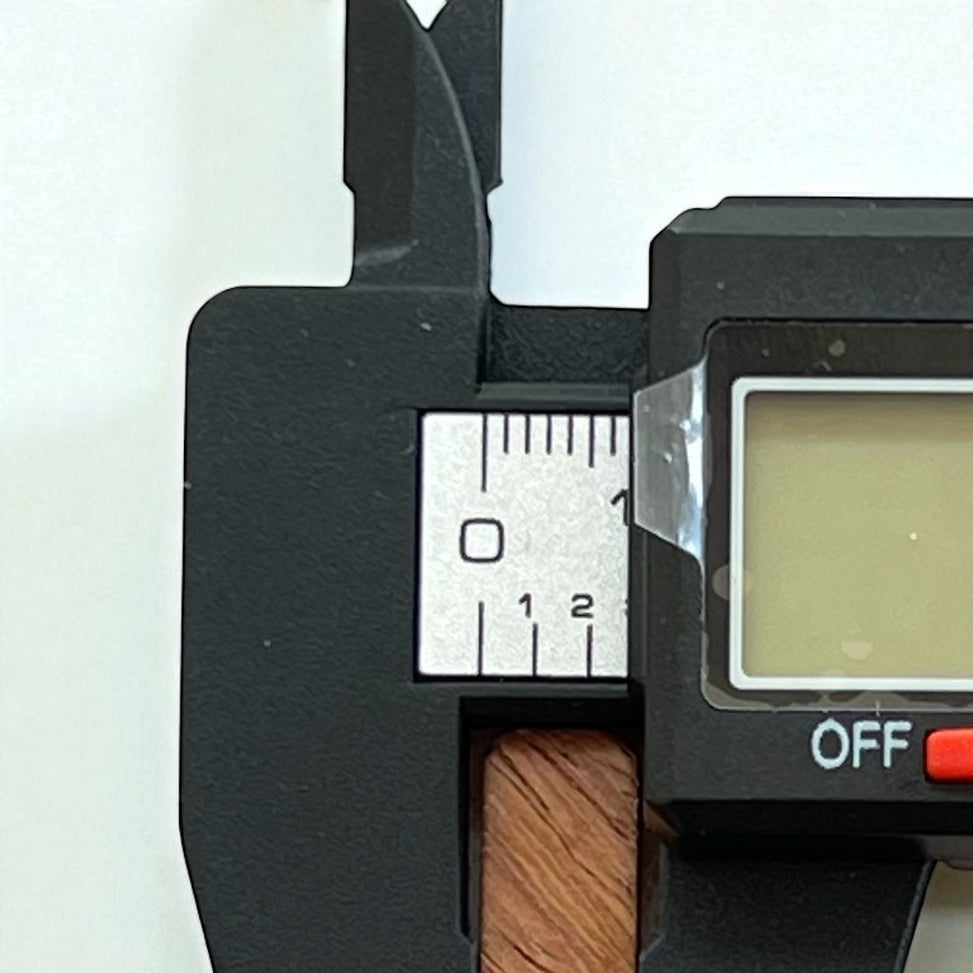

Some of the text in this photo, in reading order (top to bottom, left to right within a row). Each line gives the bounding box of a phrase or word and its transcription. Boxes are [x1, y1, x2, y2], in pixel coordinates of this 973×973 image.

[518, 593, 533, 619] 1
[570, 594, 594, 619] 2
[811, 719, 912, 770] OFF
